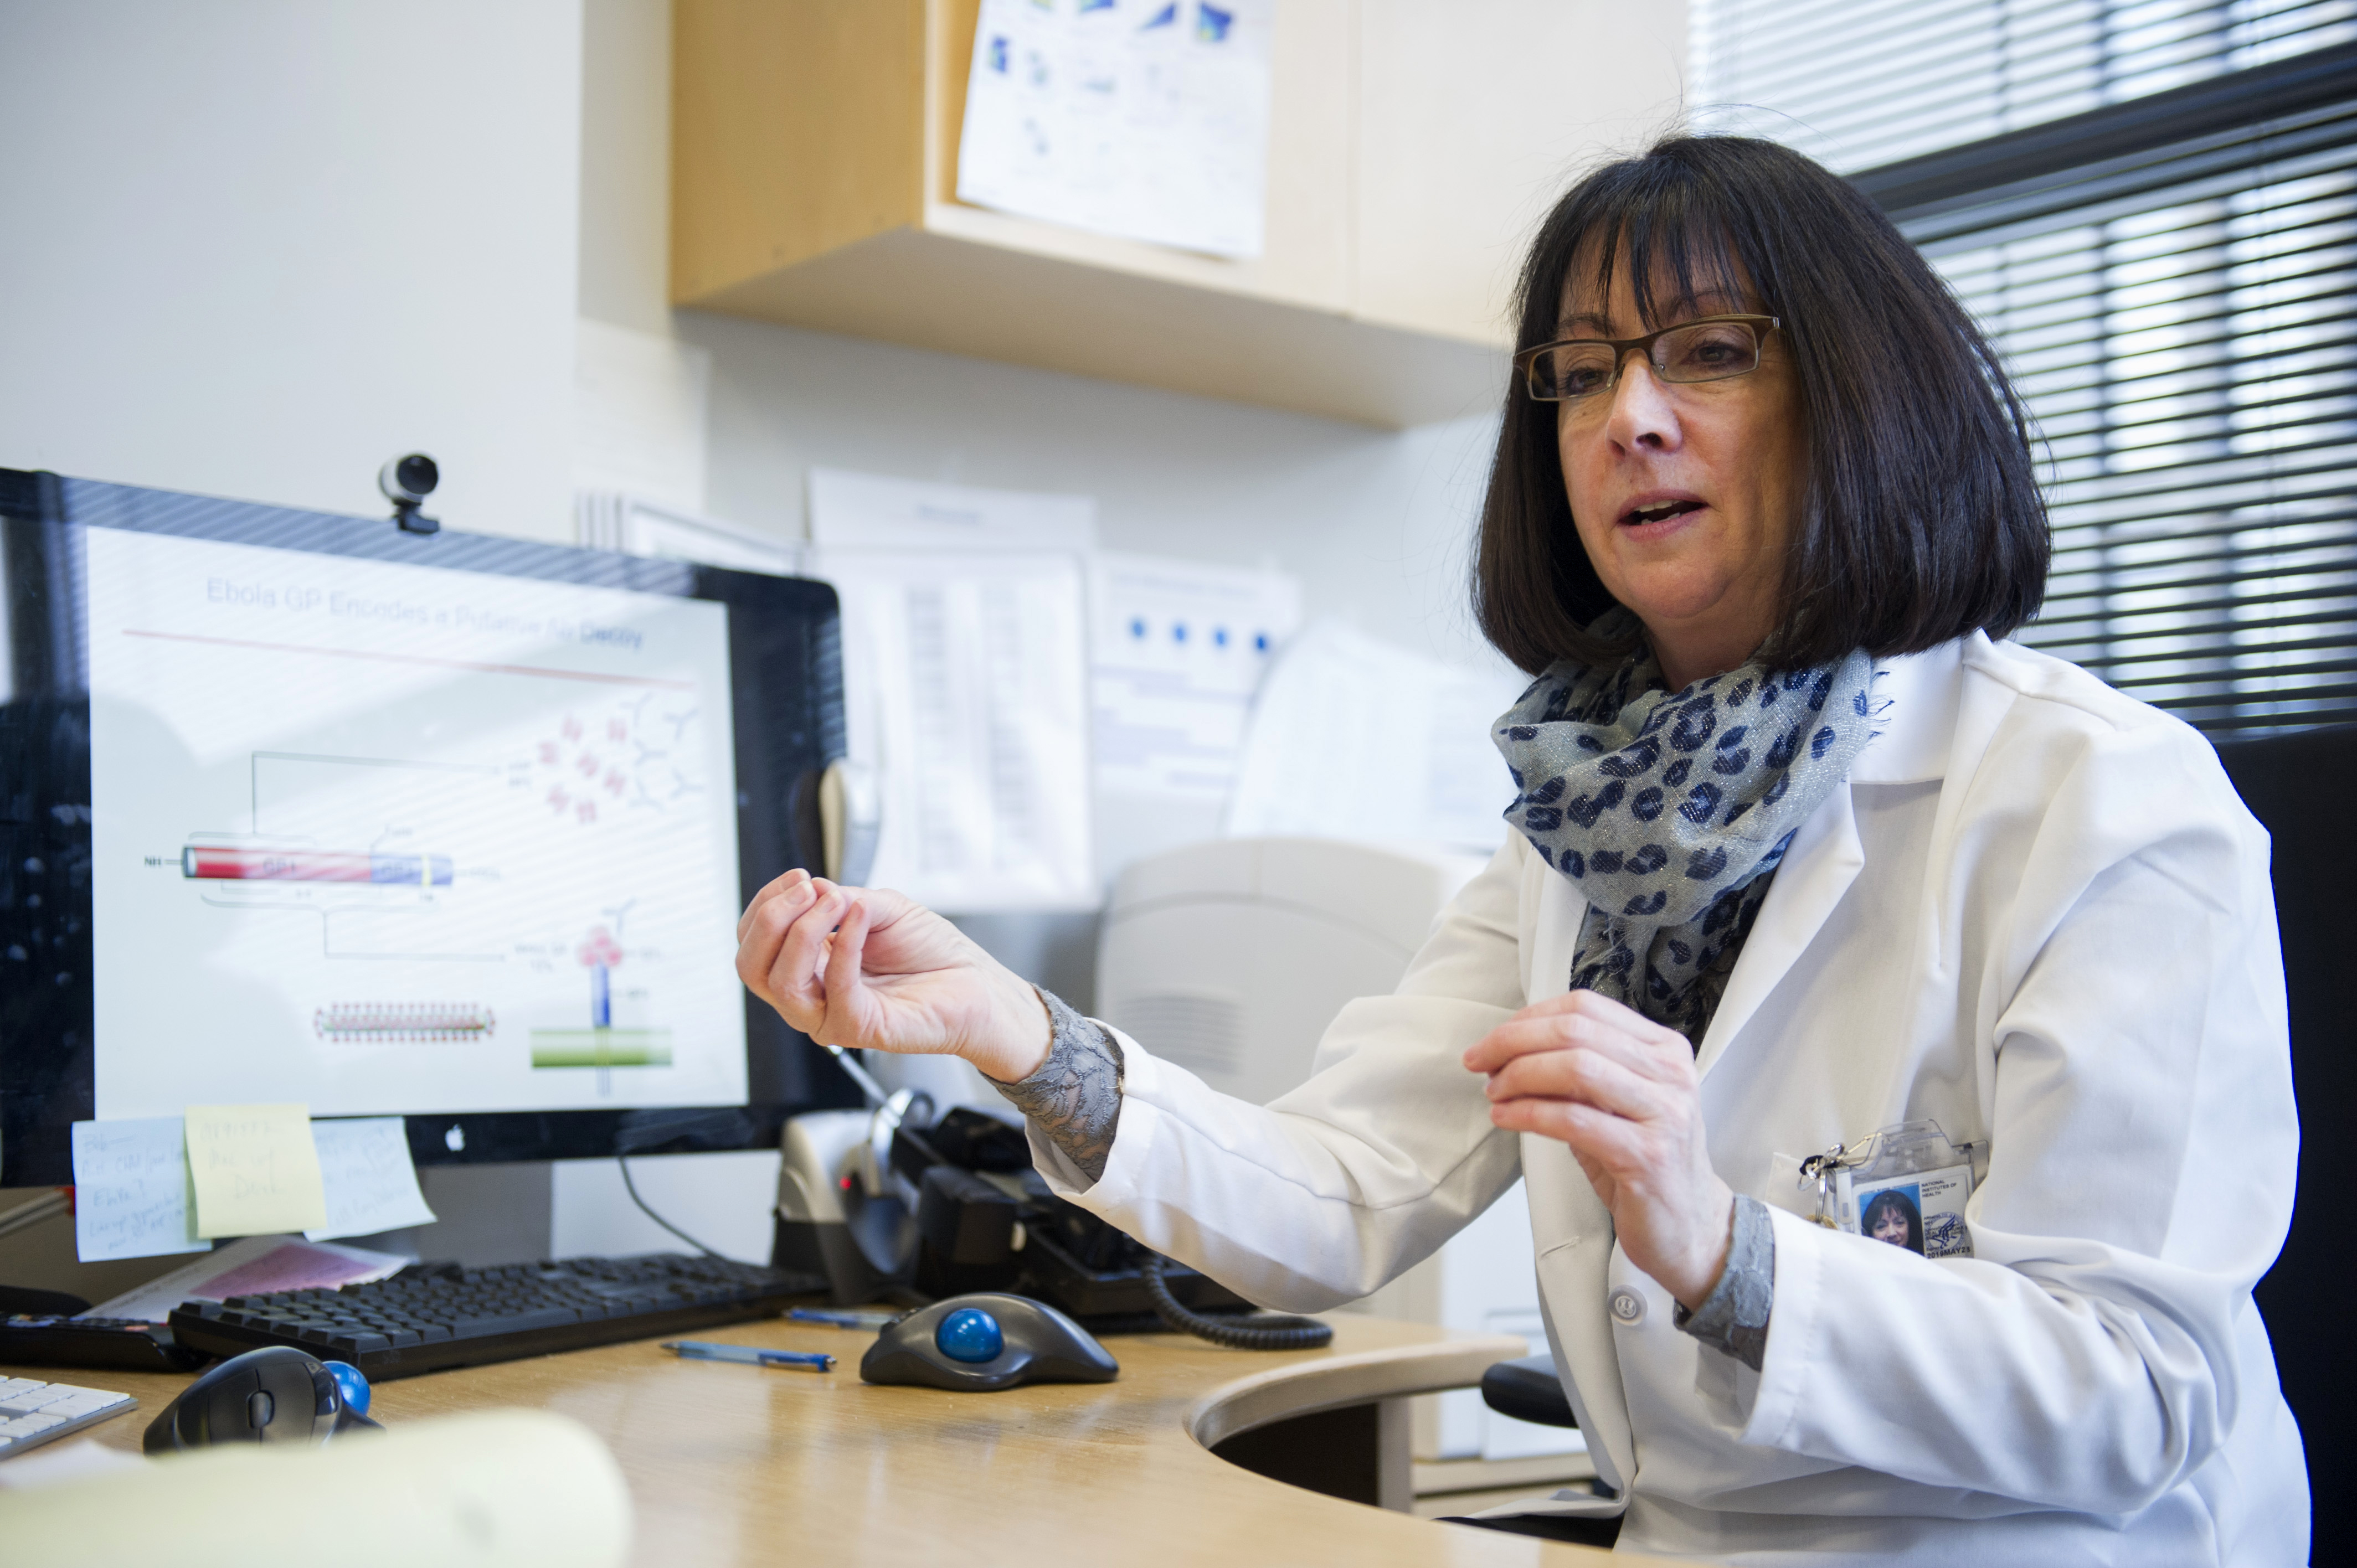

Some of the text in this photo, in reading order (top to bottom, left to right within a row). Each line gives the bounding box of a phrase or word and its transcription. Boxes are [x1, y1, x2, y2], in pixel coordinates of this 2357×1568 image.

[207, 577, 277, 608] Ebola
[285, 586, 322, 613] GP
[331, 591, 428, 626] Encodes
